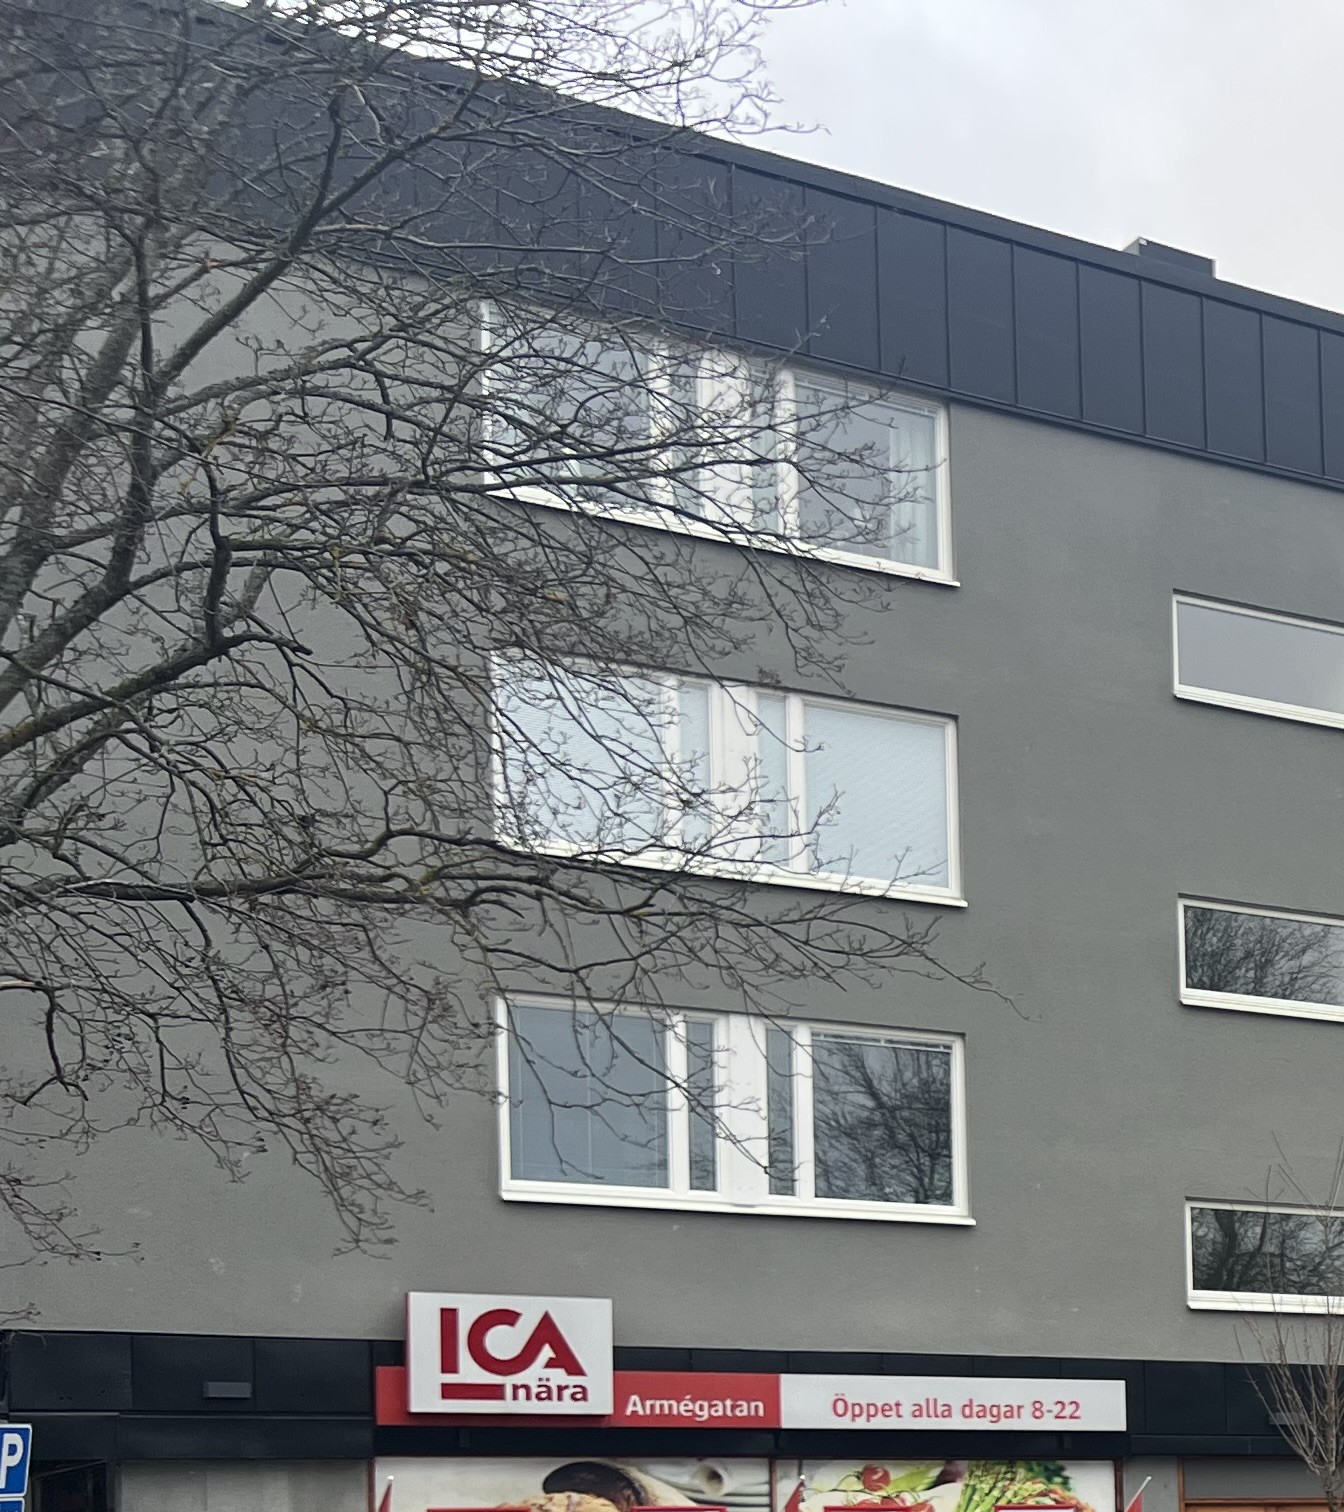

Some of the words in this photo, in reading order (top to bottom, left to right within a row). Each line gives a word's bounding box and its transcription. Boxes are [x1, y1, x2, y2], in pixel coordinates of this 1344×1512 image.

[440, 1308, 588, 1377] ICA
[512, 1377, 589, 1402] nära
[625, 1395, 765, 1421] Armégatan
[832, 1393, 904, 1422] Öppet
[911, 1399, 953, 1419] alla
[961, 1399, 1025, 1424] dagar
[1031, 1400, 1082, 1420] 8-22
[0, 1433, 24, 1489] P
